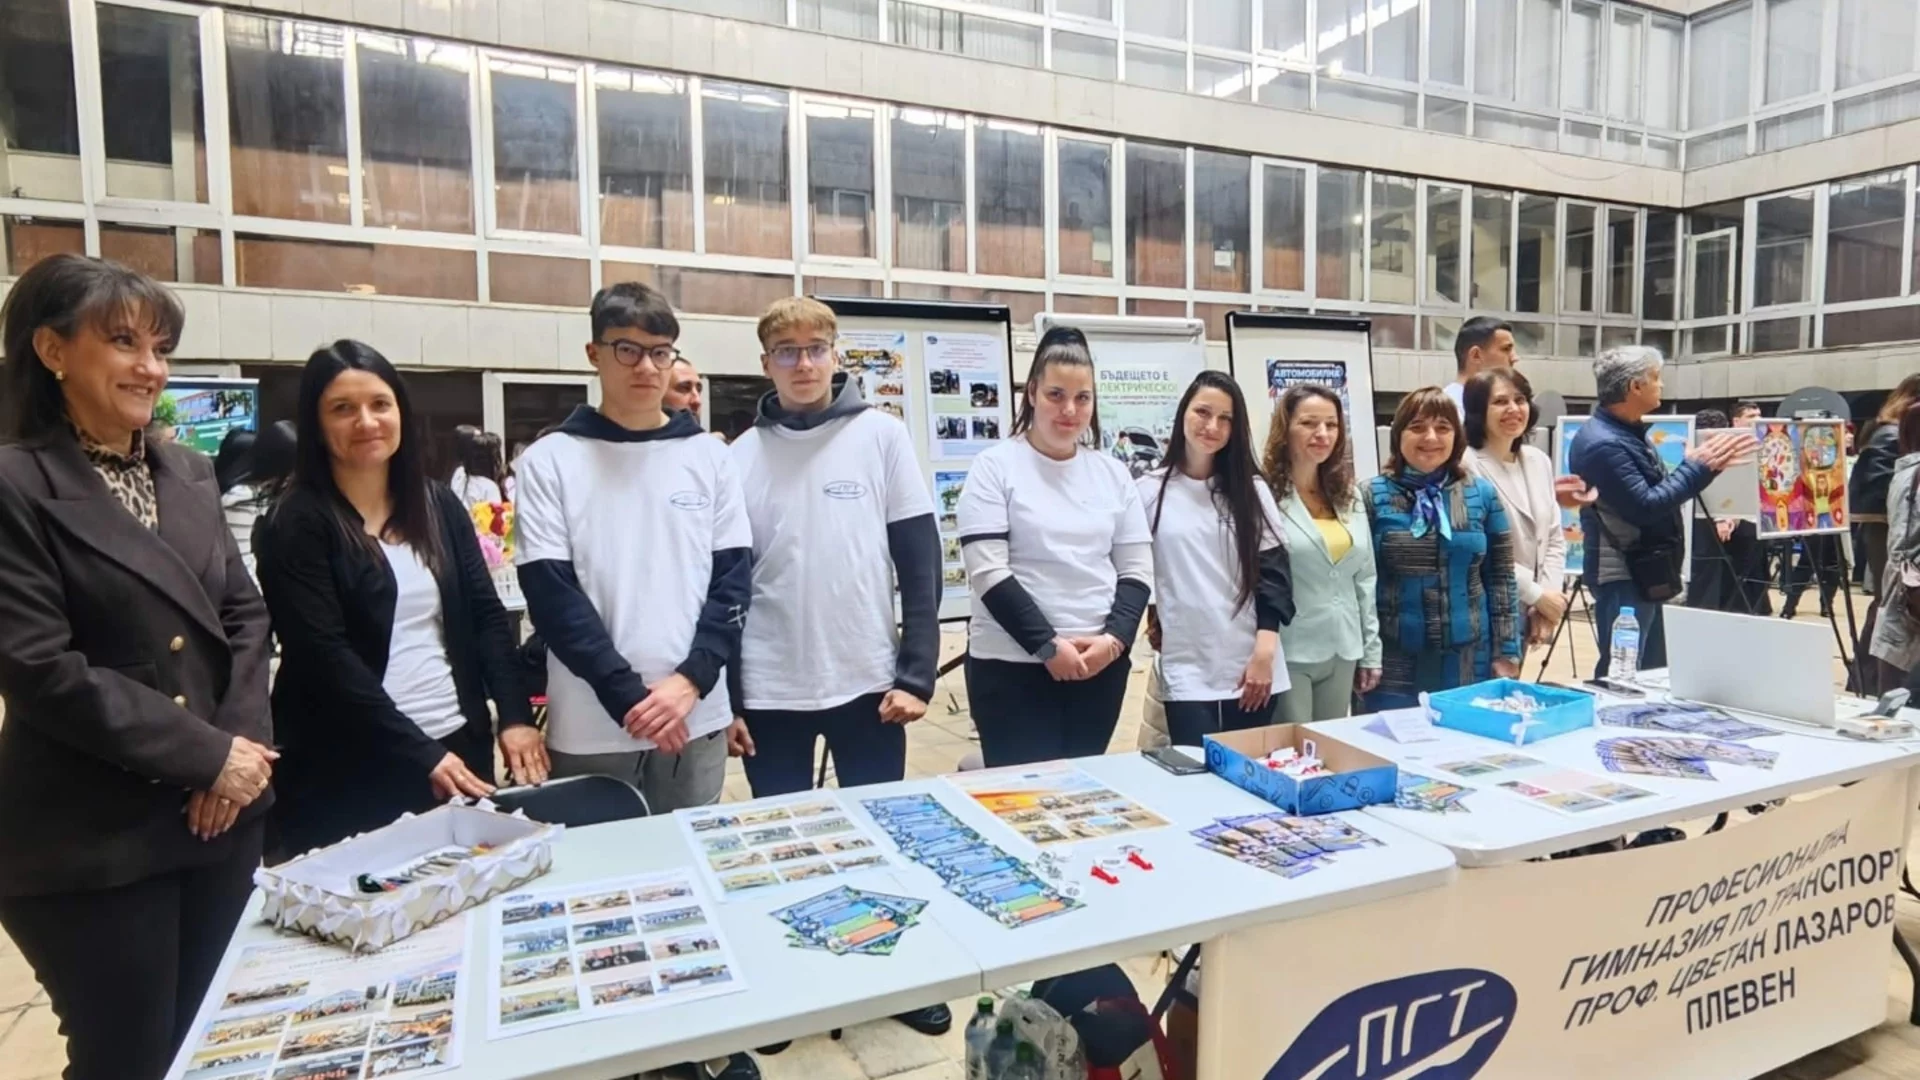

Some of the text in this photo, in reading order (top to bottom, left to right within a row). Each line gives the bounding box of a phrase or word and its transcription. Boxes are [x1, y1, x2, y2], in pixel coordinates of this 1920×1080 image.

[1100, 370, 1169, 381] БЪДЕЩЕТО Е
[1559, 847, 1901, 990] ГИМНАЗИЯ ПО ТРАНСПОРТ
[1564, 894, 1896, 1031] ПРОФ. ЦВЕТАН ЛАЗАРОВ
[1356, 979, 1486, 1077] ПГТ
[1687, 966, 1796, 1034] ПЛЕВЕН
